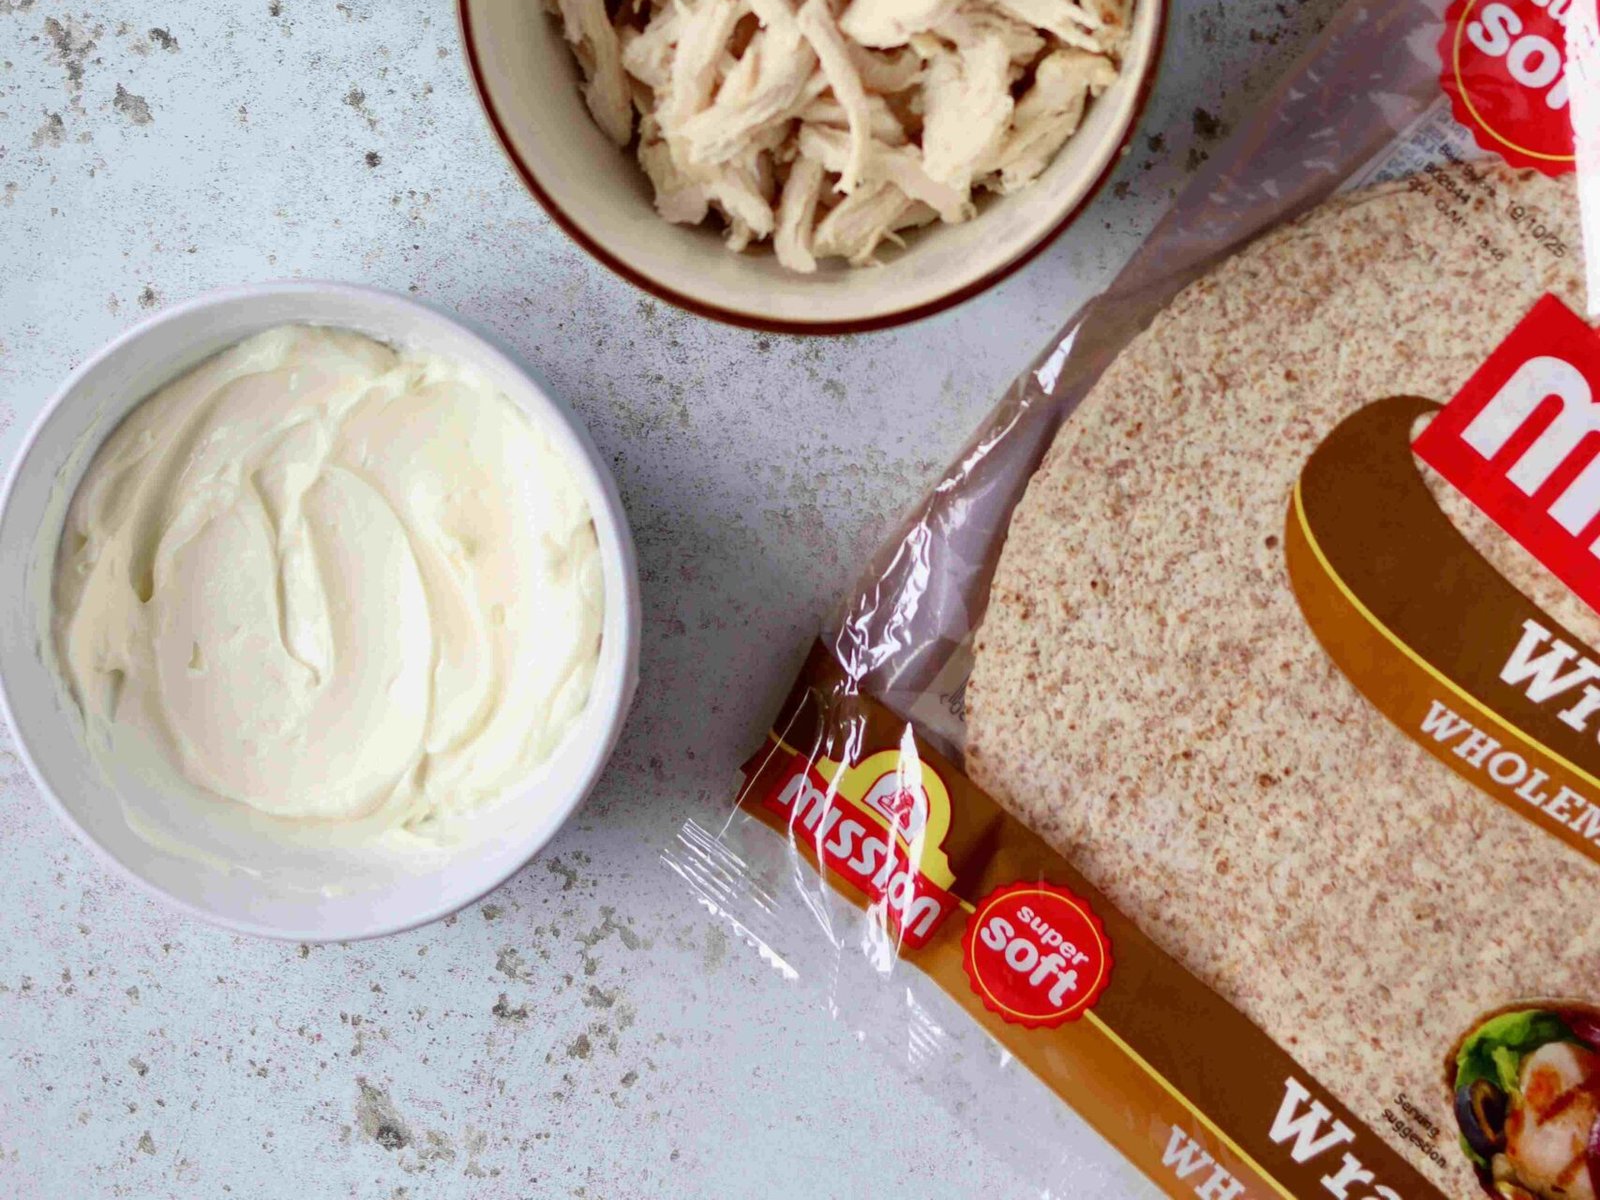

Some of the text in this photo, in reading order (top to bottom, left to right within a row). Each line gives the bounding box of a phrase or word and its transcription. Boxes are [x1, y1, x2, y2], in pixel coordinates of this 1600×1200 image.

[1500, 618, 1600, 742] Wr
[777, 773, 941, 937] mission
[980, 917, 1077, 1007] soft
[1017, 906, 1089, 965] super
[1382, 1109, 1447, 1169] suggestion
[1394, 1093, 1440, 1139] Serving
